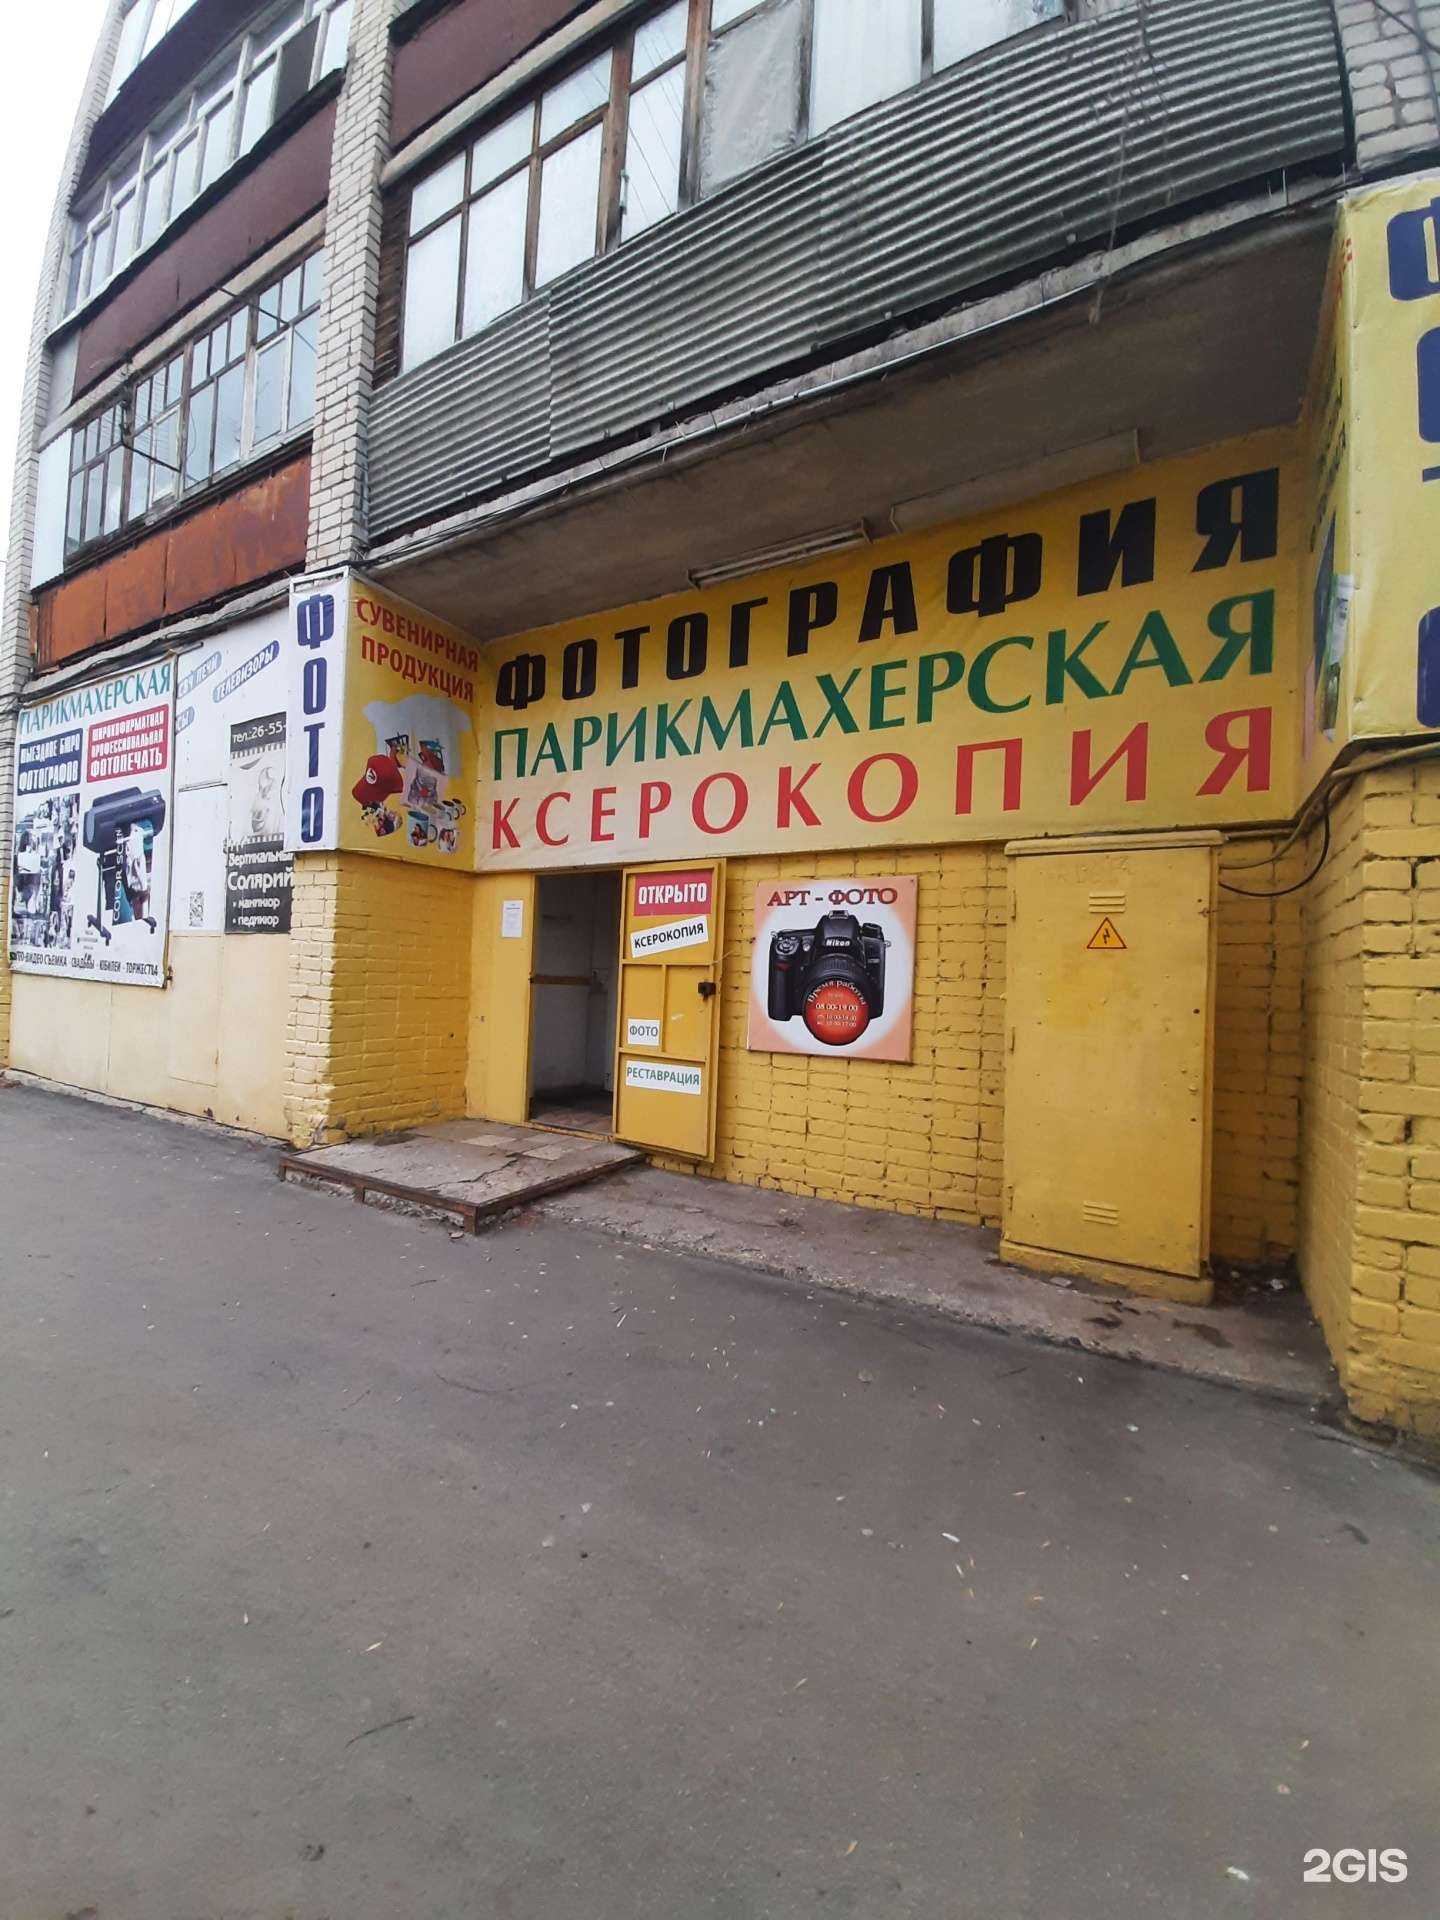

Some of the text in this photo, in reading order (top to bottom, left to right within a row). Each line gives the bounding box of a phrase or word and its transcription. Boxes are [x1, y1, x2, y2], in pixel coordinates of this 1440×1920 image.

[495, 467, 1279, 710] ФОТОГРАФИЯ
[356, 597, 479, 672] СУВЕНИРНАЯ
[217, 643, 275, 700] ТЕЛЕВИЗОРЫ
[361, 636, 474, 703] ПРОДУКЦИЯ
[20, 663, 171, 735] ПАРИКМАХЕРСКАЯ
[493, 588, 1275, 781] ПАРИКМАХЕРСКАЯ
[296, 593, 335, 844] ФОТО
[60, 734, 80, 754] БЮРО
[19, 760, 79, 791] ФОТОГРАФОВ
[90, 747, 163, 778] ФОТОПЕЧАТЬ
[491, 707, 1273, 849] КСЕРОКОПИЯ
[227, 866, 294, 893] Солярий
[638, 882, 707, 905] ОТКРЫТО
[113, 869, 123, 922] COLOR
[238, 897, 280, 910] маникюр
[767, 890, 810, 906] АРТ
[828, 888, 898, 905] ФОТО
[238, 916, 279, 927] педикюр
[634, 923, 704, 949] КСЕРОКОПИЯ
[825, 938, 850, 947] Nikon
[126, 962, 158, 976] ТОРЖЕСТВА
[629, 1025, 659, 1037] ФОТО
[627, 1067, 700, 1086] РЕСТАВРАЦИЯ
